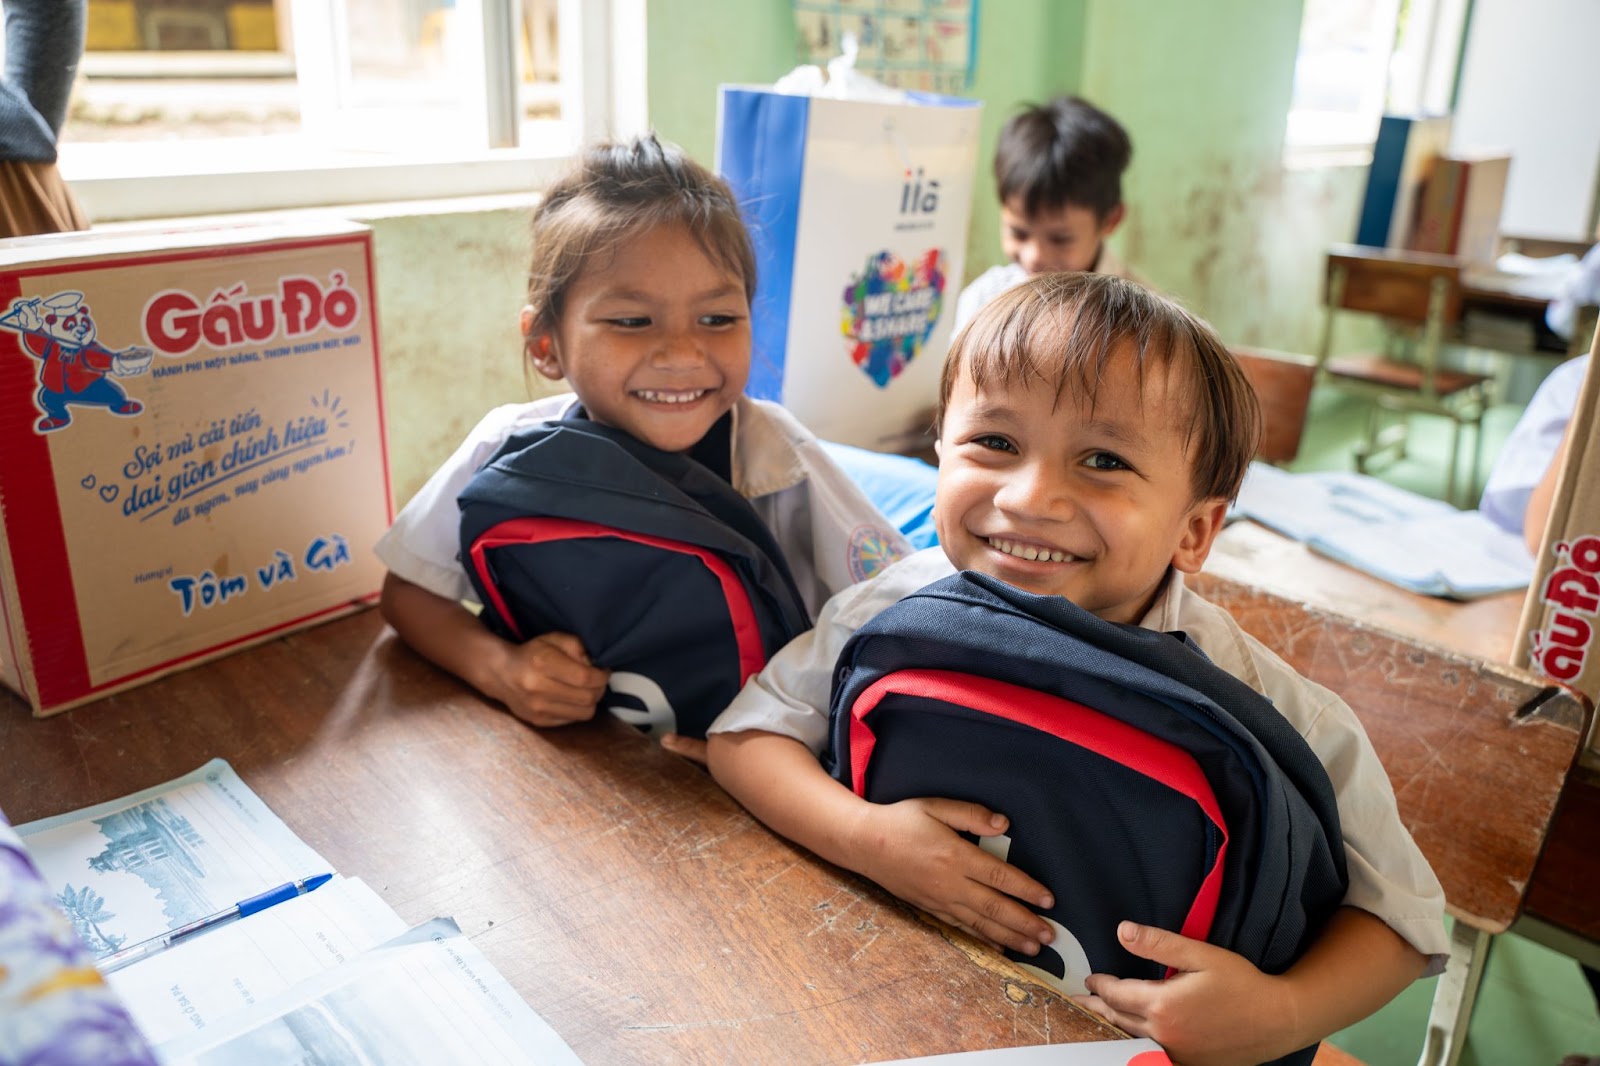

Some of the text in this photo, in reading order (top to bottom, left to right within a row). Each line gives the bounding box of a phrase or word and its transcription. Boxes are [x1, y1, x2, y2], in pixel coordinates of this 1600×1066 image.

[146, 273, 356, 354] Gấu Đỏ
[123, 474, 164, 516] dai
[170, 533, 349, 614] Tôm và Gà
[1533, 612, 1591, 681] ấu
